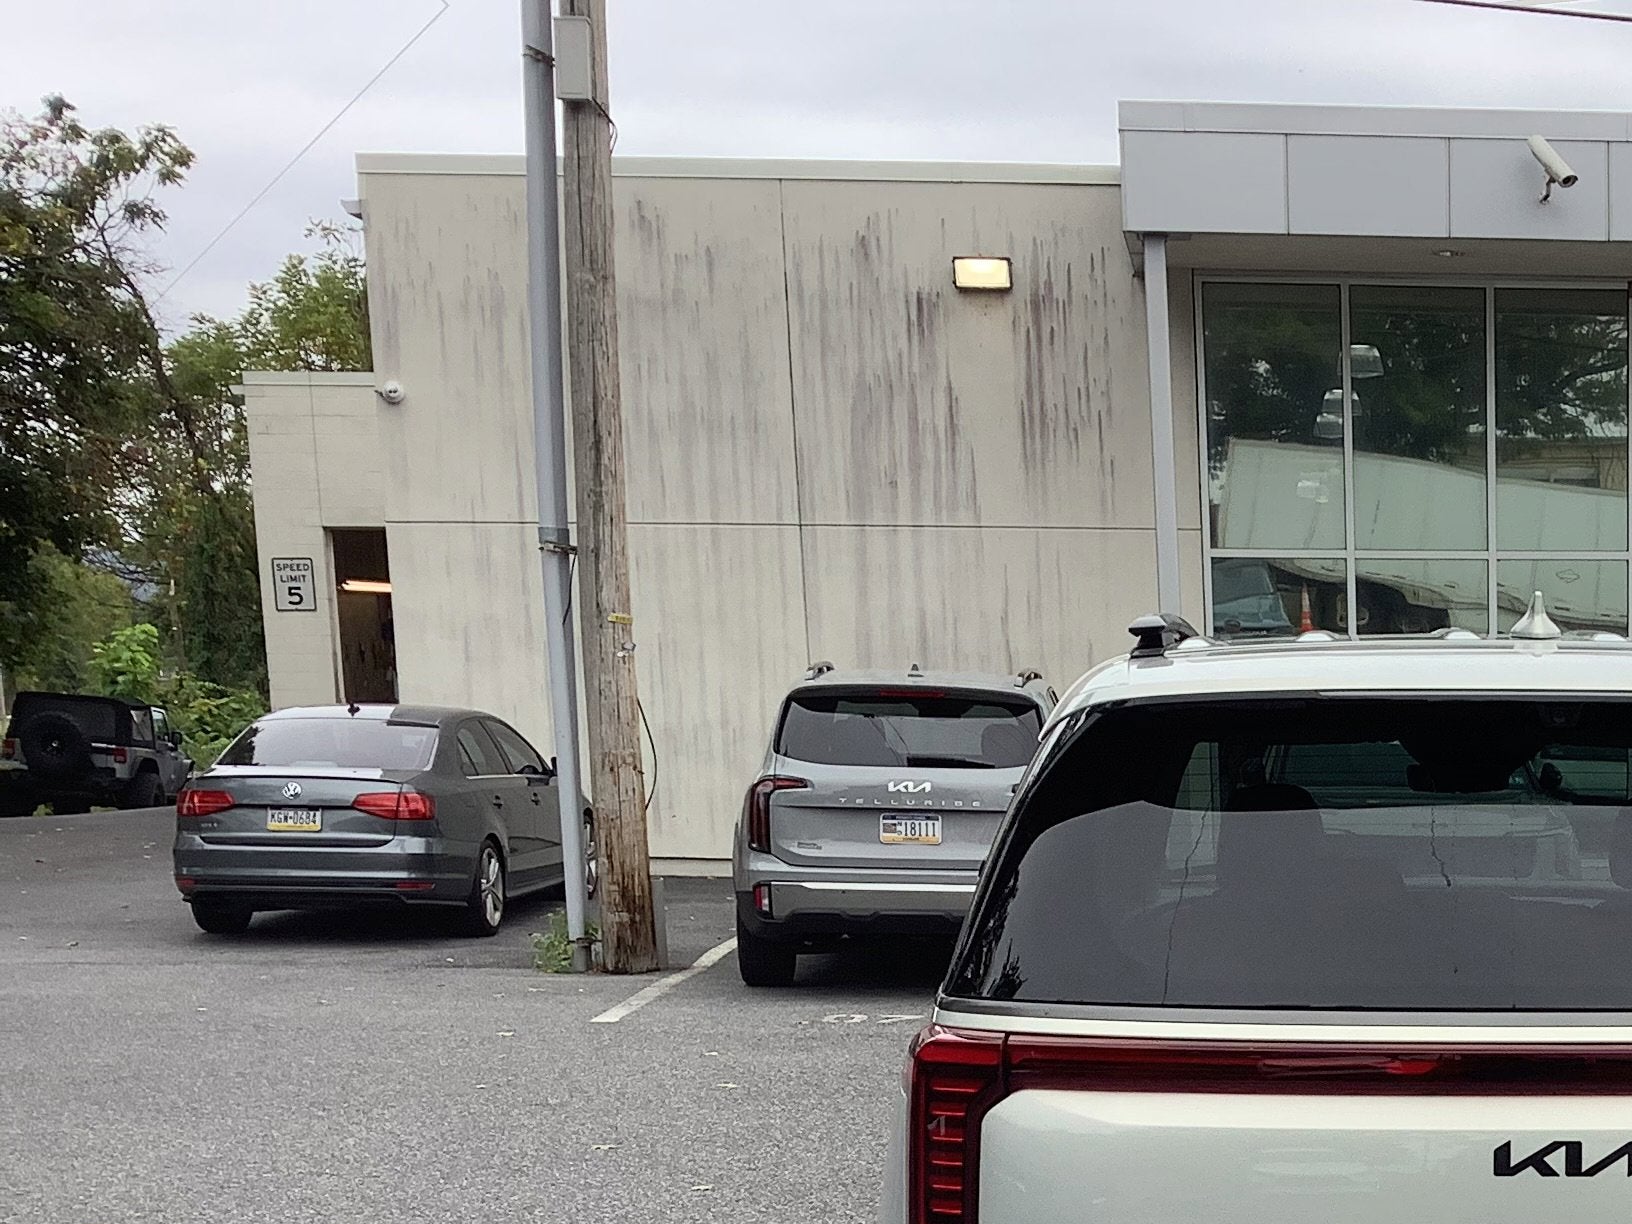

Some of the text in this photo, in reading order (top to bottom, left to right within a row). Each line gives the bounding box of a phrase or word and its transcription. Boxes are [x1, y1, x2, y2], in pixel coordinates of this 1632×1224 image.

[276, 563, 310, 572] SPEED
[280, 574, 306, 583] LIMIT
[288, 586, 304, 606] 5
[888, 781, 931, 793] KIA
[839, 798, 981, 807] TELLURIDE
